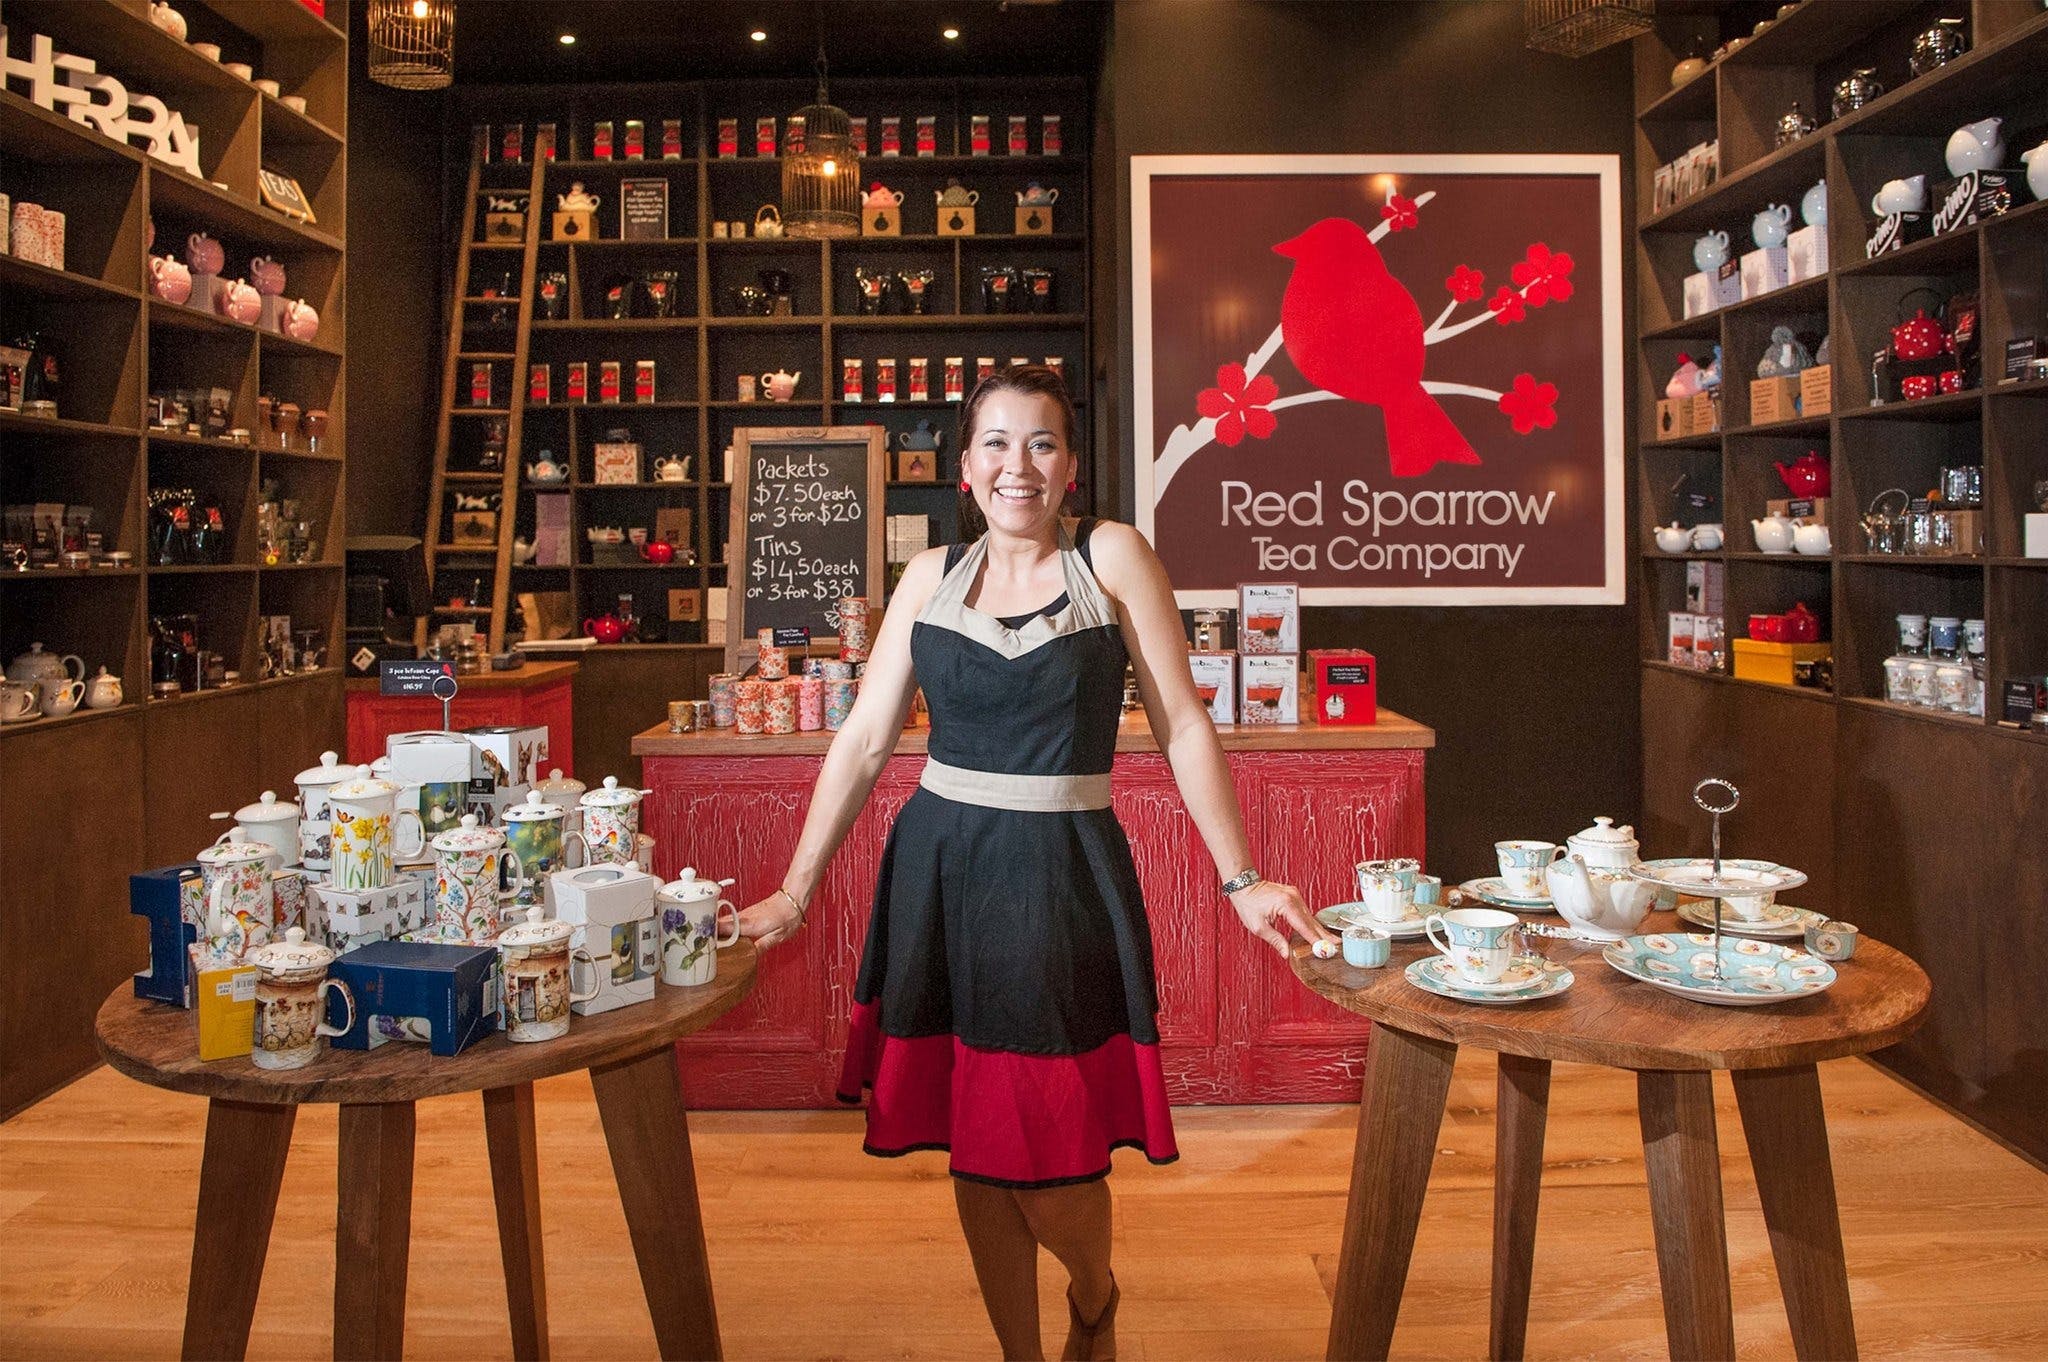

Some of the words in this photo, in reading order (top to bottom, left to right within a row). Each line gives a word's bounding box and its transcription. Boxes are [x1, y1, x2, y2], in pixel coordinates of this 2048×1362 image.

[259, 169, 299, 202] TEAS
[757, 453, 830, 480] Packets
[749, 511, 767, 523] or
[772, 506, 788, 528] 3
[789, 506, 816, 522] for
[817, 502, 862, 526] $20
[1221, 480, 1324, 527] Red
[1342, 479, 1556, 537] Sparrow
[754, 534, 802, 557] Tins
[1251, 536, 1317, 571] Tea
[1327, 535, 1525, 578] Company
[746, 587, 763, 599] or
[767, 583, 782, 601] 3
[783, 585, 810, 600] for
[813, 578, 855, 601] $38
